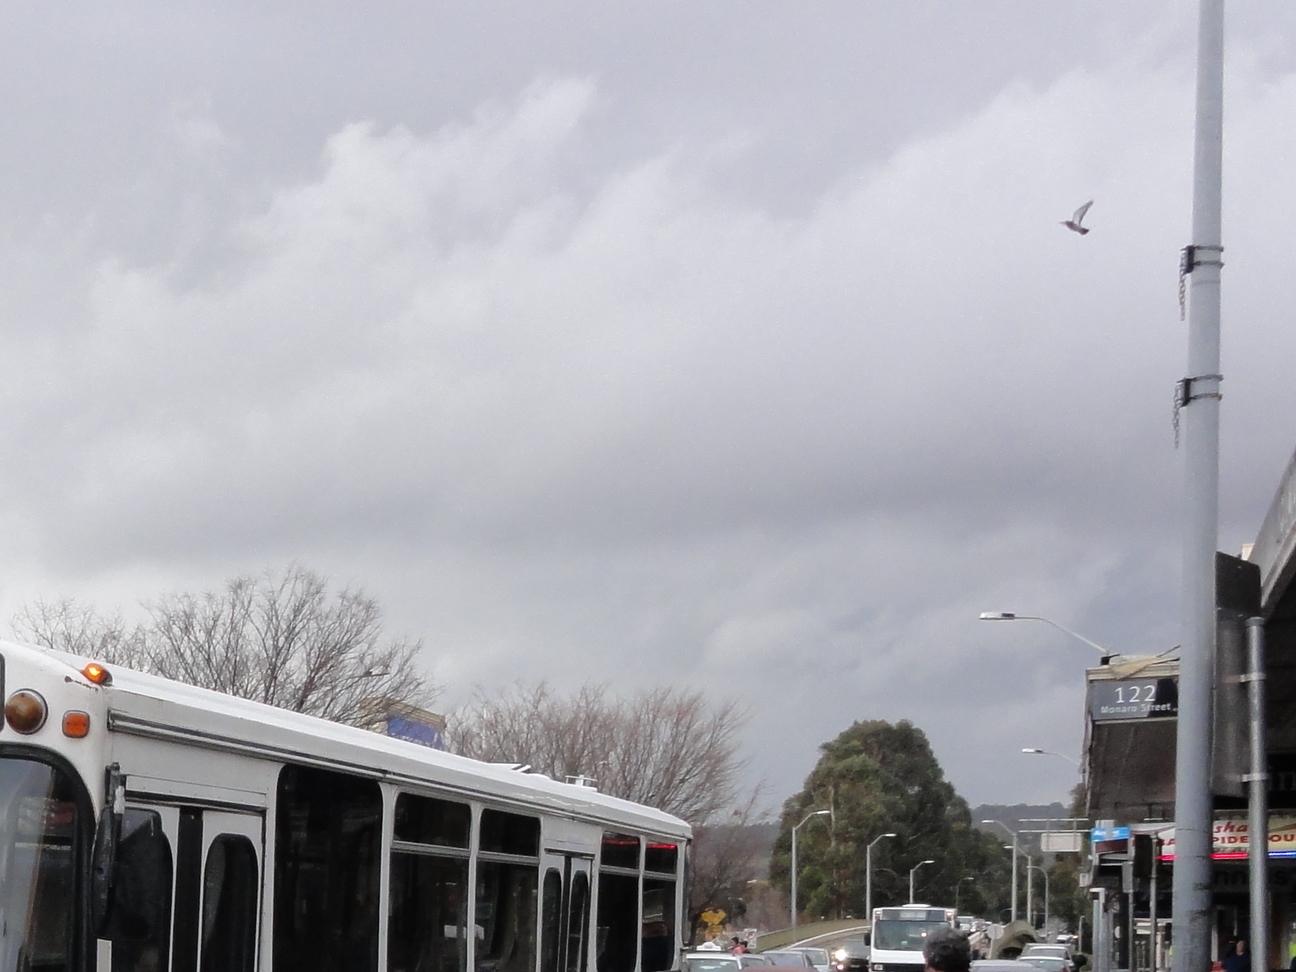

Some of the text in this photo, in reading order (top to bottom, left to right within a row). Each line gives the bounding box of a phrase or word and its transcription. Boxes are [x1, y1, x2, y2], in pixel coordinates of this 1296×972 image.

[1115, 685, 1157, 703] 122
[1101, 705, 1138, 713] Monaro
[1140, 702, 1172, 713] Street
